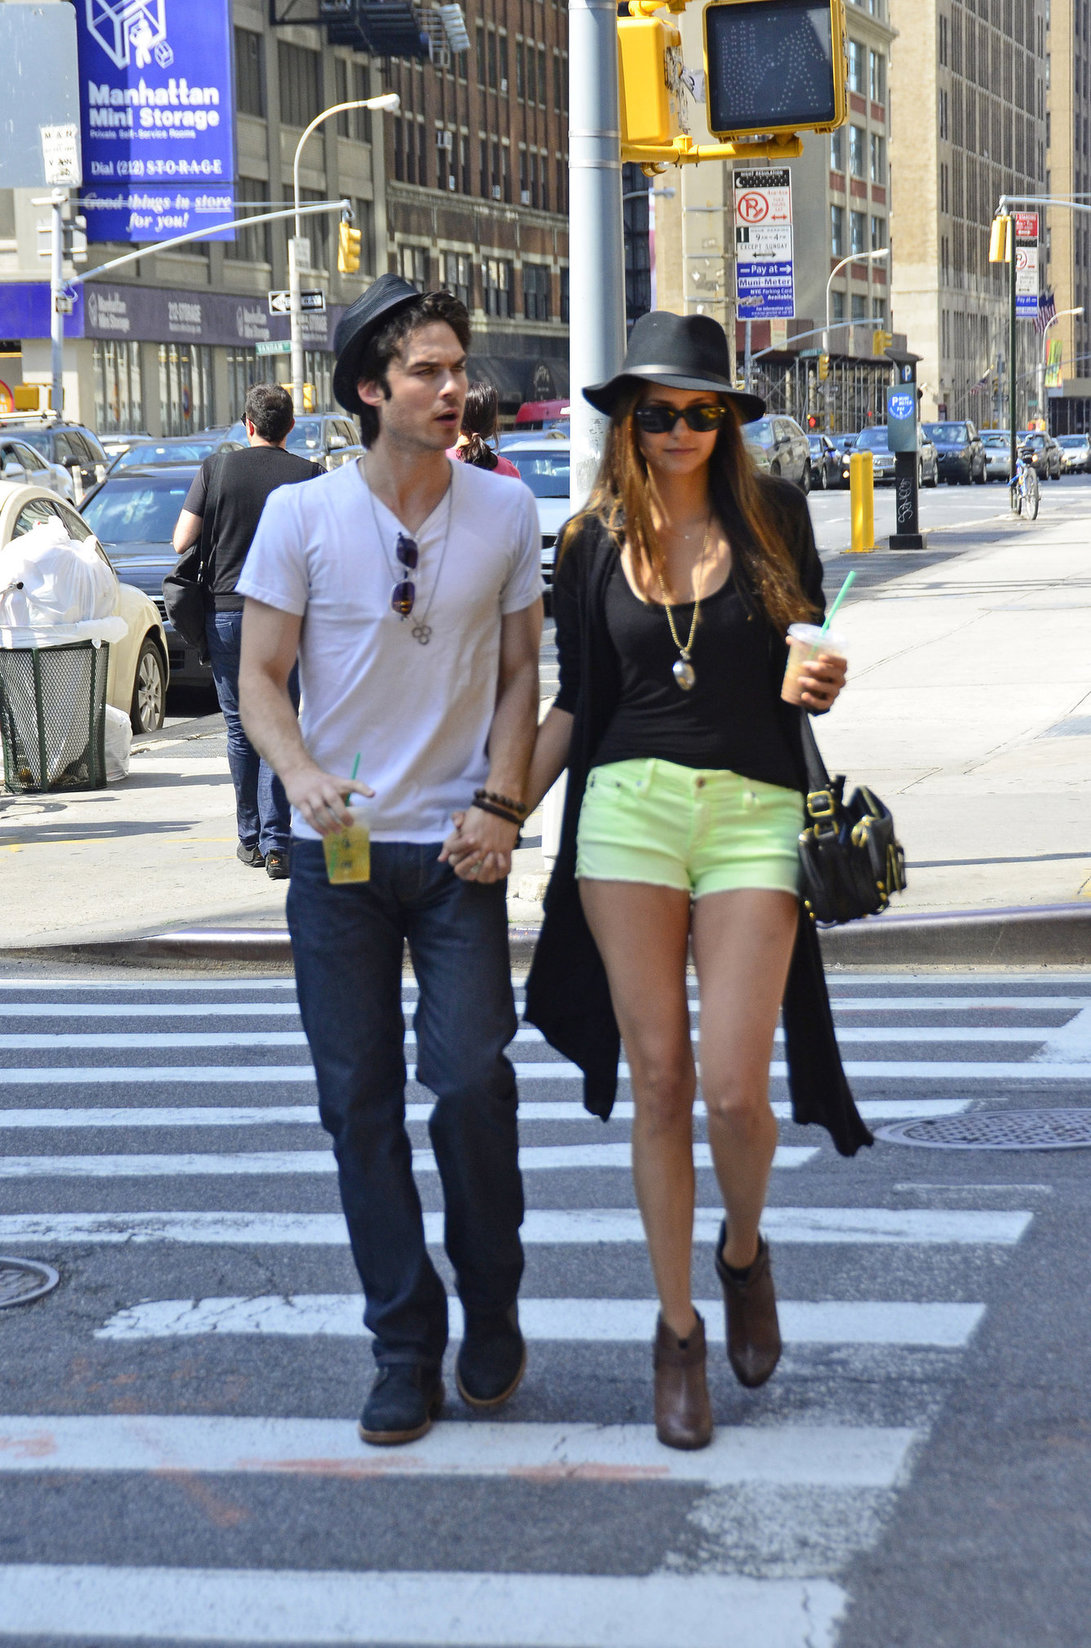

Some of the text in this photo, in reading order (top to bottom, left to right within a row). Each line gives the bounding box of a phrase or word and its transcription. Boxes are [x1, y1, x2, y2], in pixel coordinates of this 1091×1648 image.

[88, 76, 220, 106] Manhattan
[89, 107, 220, 131] Mini Storage
[91, 160, 113, 175] Dial
[117, 160, 144, 176] (212)
[85, 192, 232, 214] Good things in store
[126, 212, 189, 233] for you!
[751, 264, 778, 275] Pay at
[739, 278, 791, 287] Muni-Meter
[904, 364, 912, 381] P
